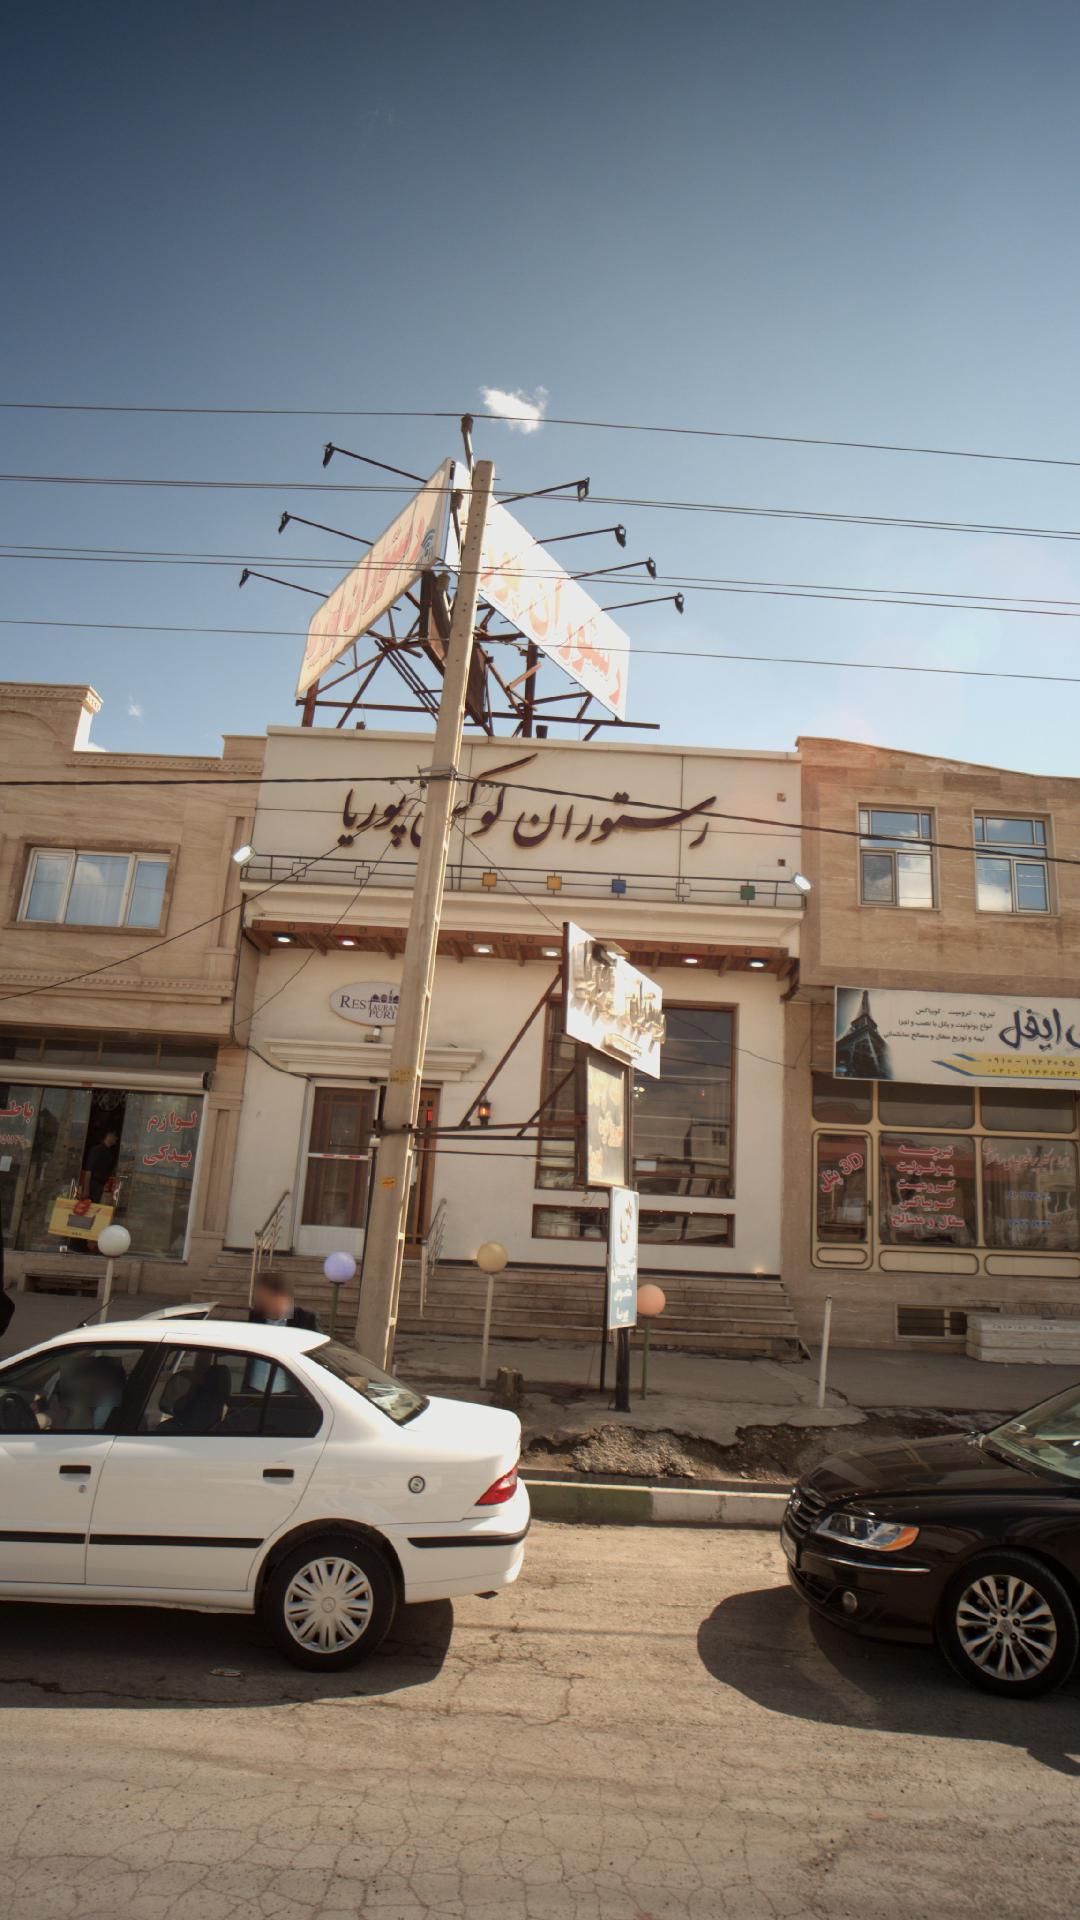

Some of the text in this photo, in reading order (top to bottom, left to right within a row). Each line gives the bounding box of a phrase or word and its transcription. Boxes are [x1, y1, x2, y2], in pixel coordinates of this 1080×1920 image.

[337, 788, 408, 848] پوریا
[513, 791, 717, 849] رستوران
[998, 1008, 1062, 1051] ایفل
[146, 1110, 198, 1133] لوازم
[143, 1144, 193, 1168] یدکی
[838, 1152, 864, 1175] 3D
[890, 1212, 966, 1231] سفال و مصالح
